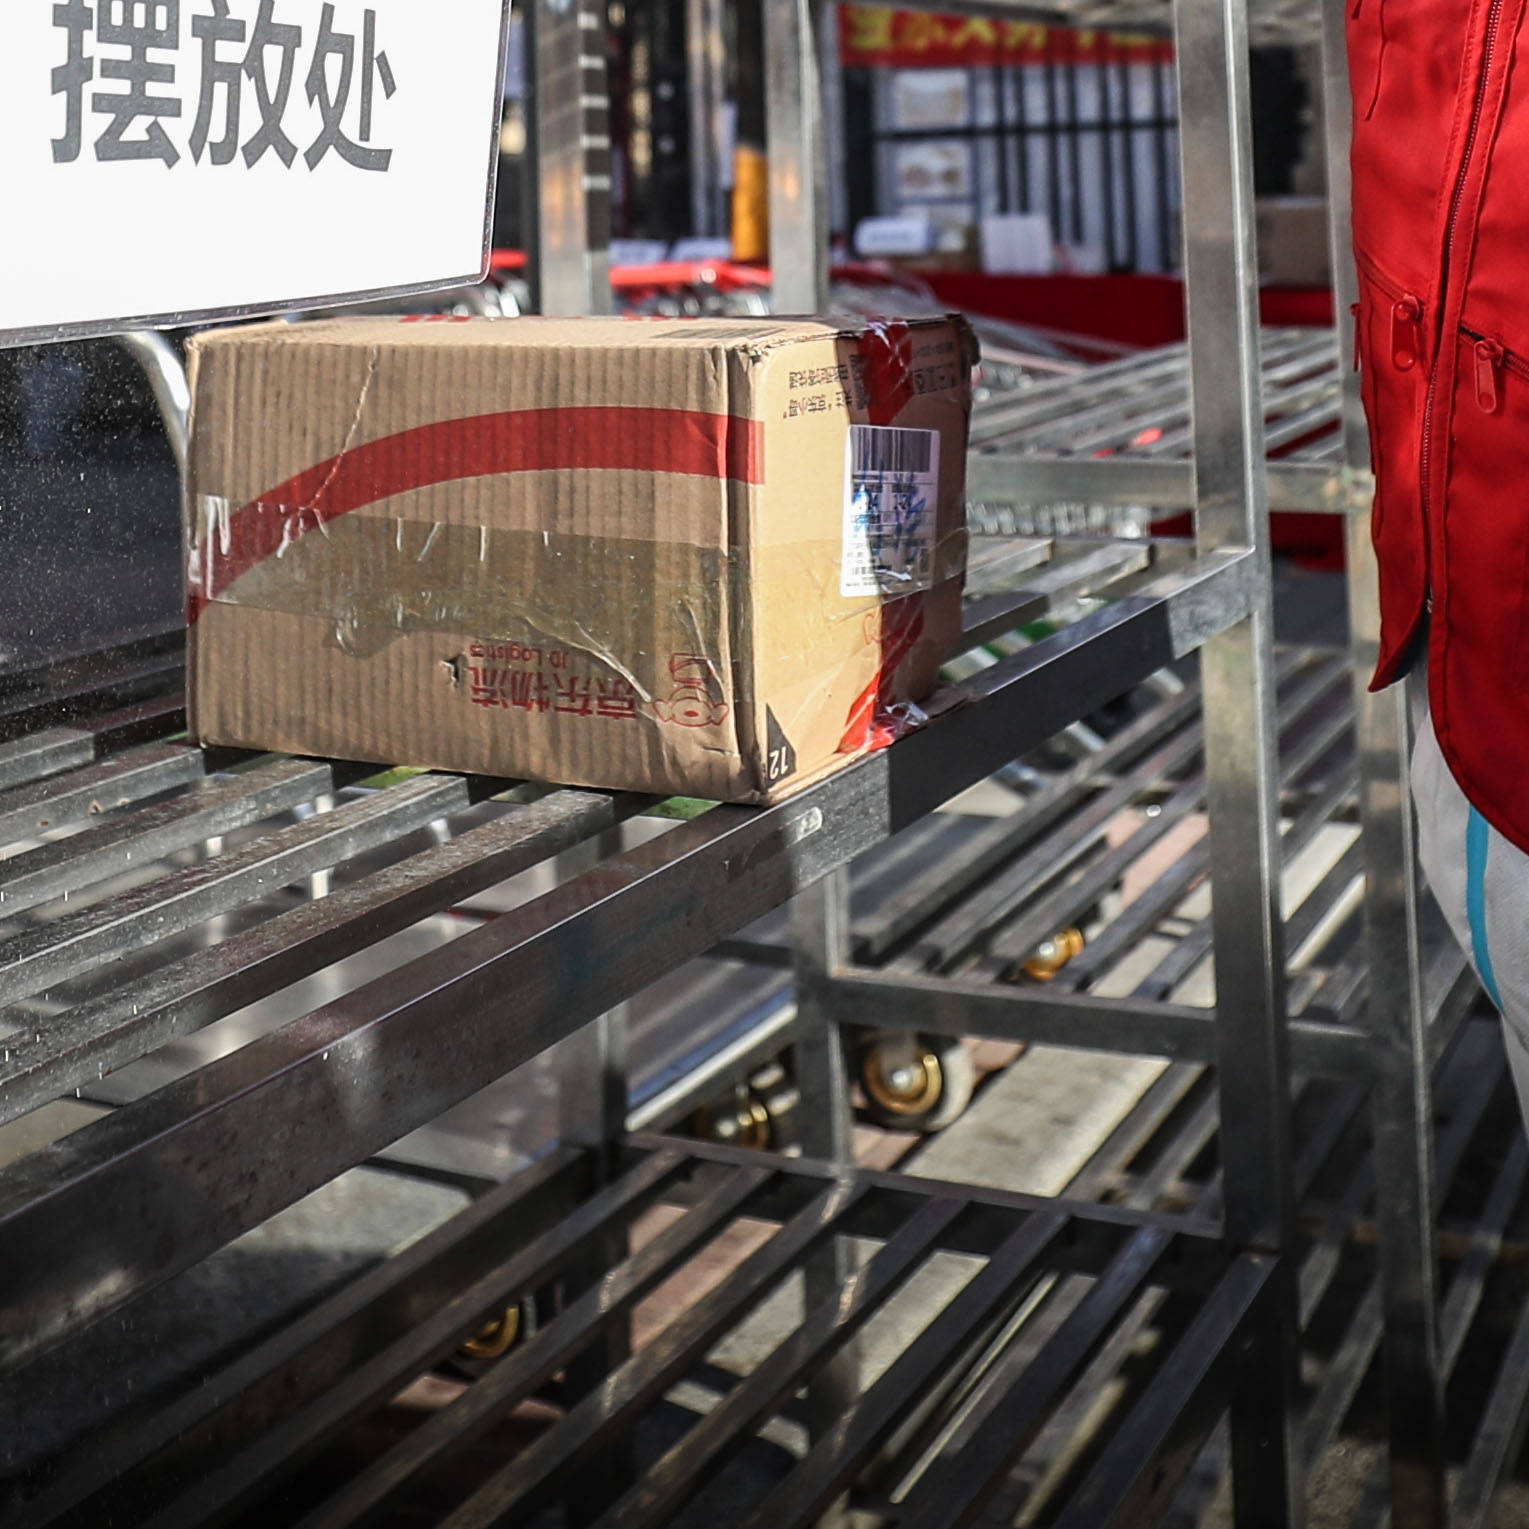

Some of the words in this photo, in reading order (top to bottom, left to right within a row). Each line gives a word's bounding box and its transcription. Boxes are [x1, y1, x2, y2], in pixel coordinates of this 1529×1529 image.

[470, 640, 543, 667] Logistics
[549, 649, 570, 669] JD
[466, 666, 637, 720] 京东物流
[769, 745, 789, 780] 12
